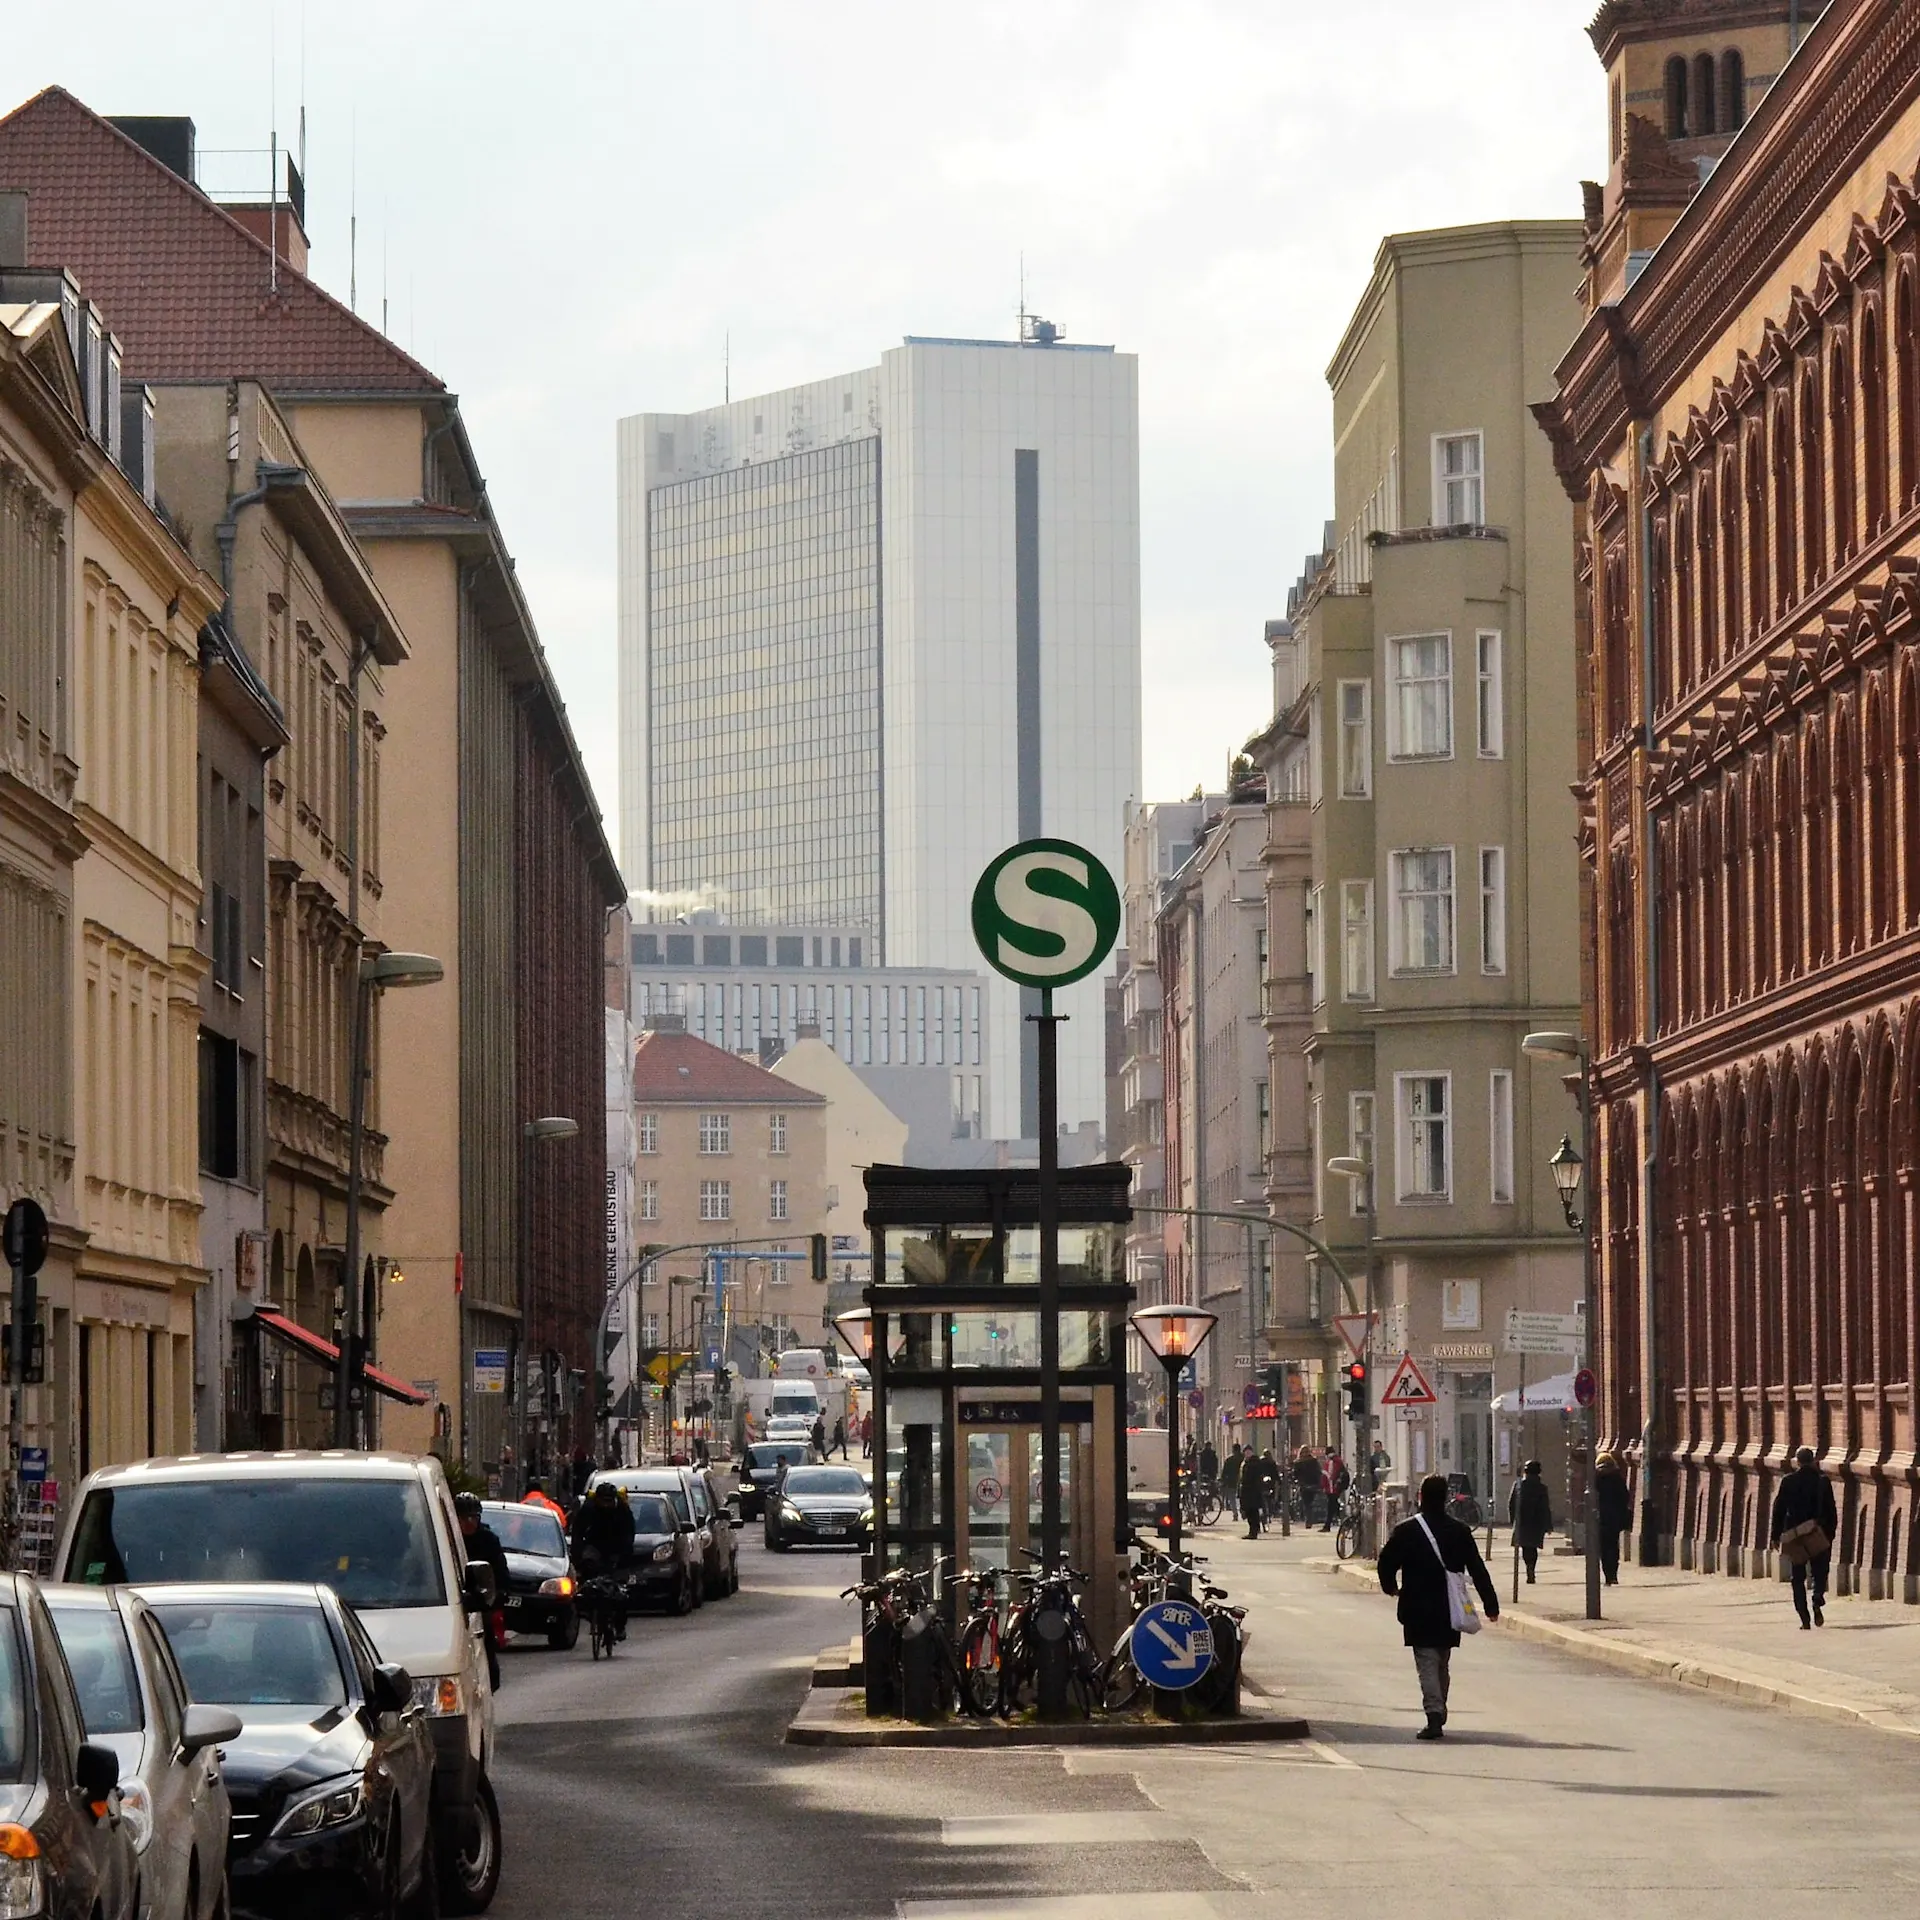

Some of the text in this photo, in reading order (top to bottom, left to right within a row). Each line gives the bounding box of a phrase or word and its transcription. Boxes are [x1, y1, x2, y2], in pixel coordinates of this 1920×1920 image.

[994, 851, 1098, 977] S
[607, 1247, 617, 1290] MENKE
[1433, 1345, 1490, 1356] LAWRENCE
[1526, 1396, 1563, 1406] Krombacher
[1192, 1630, 1209, 1642] BNE
